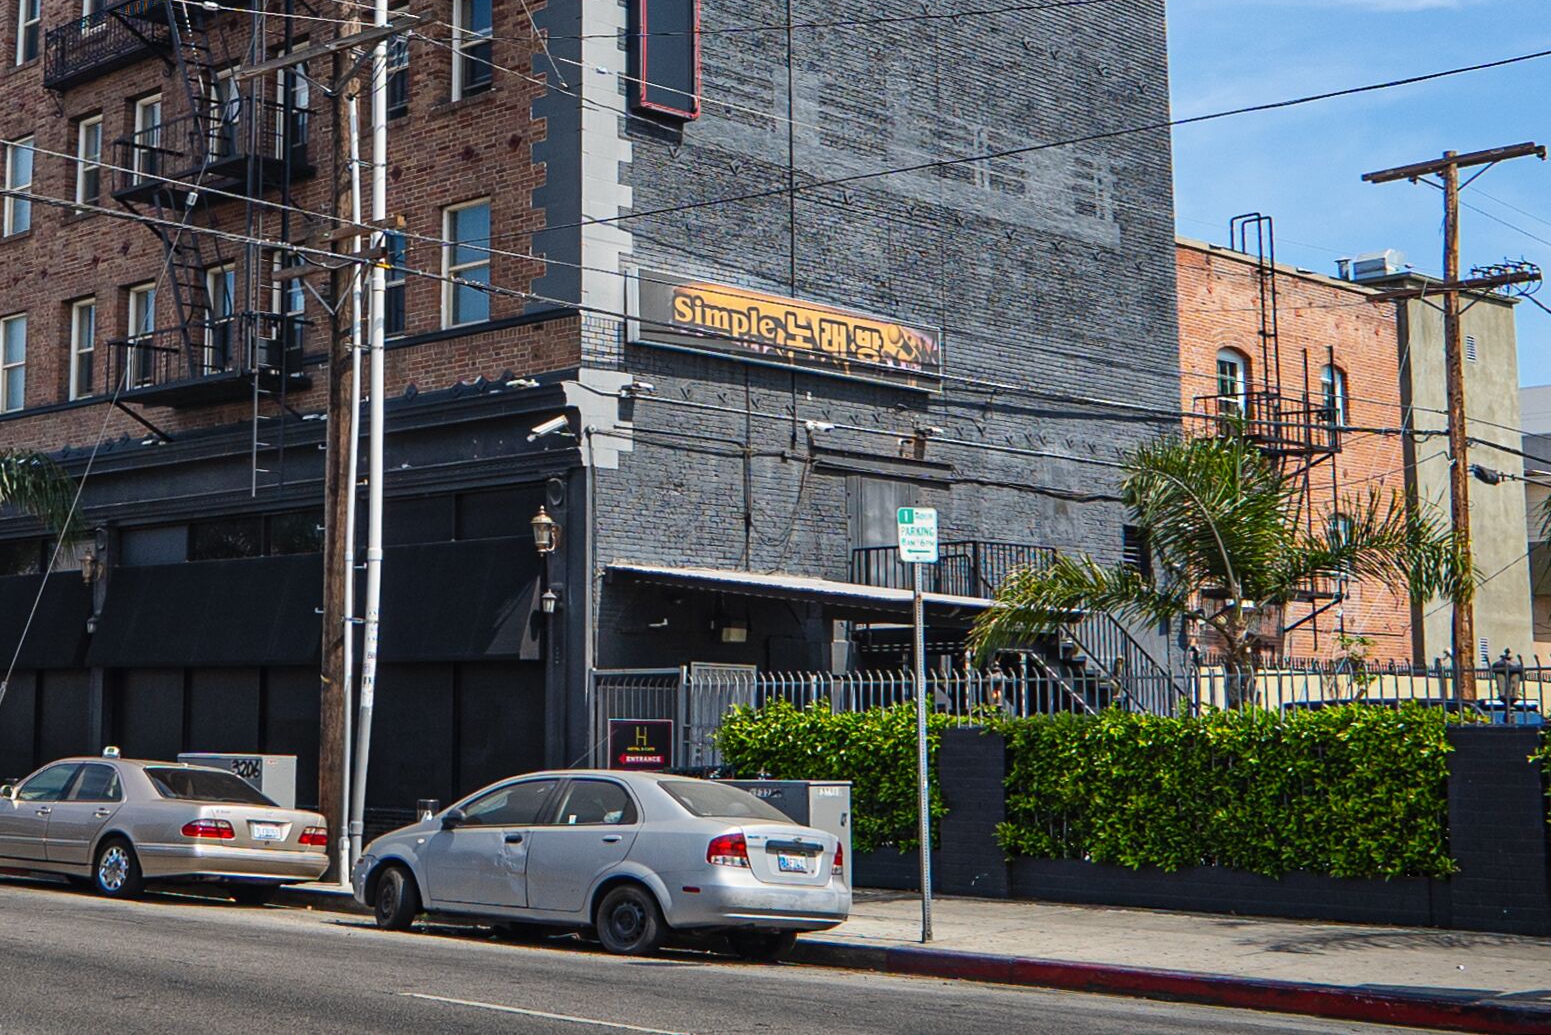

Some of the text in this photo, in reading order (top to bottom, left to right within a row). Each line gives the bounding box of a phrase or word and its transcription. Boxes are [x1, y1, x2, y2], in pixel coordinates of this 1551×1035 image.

[673, 296, 883, 363] Simple 노래방
[904, 510, 908, 522] 1
[900, 526, 935, 537] PARKING
[636, 726, 647, 746] H
[625, 755, 661, 763] ENTRANCE
[231, 758, 261, 778] 3206
